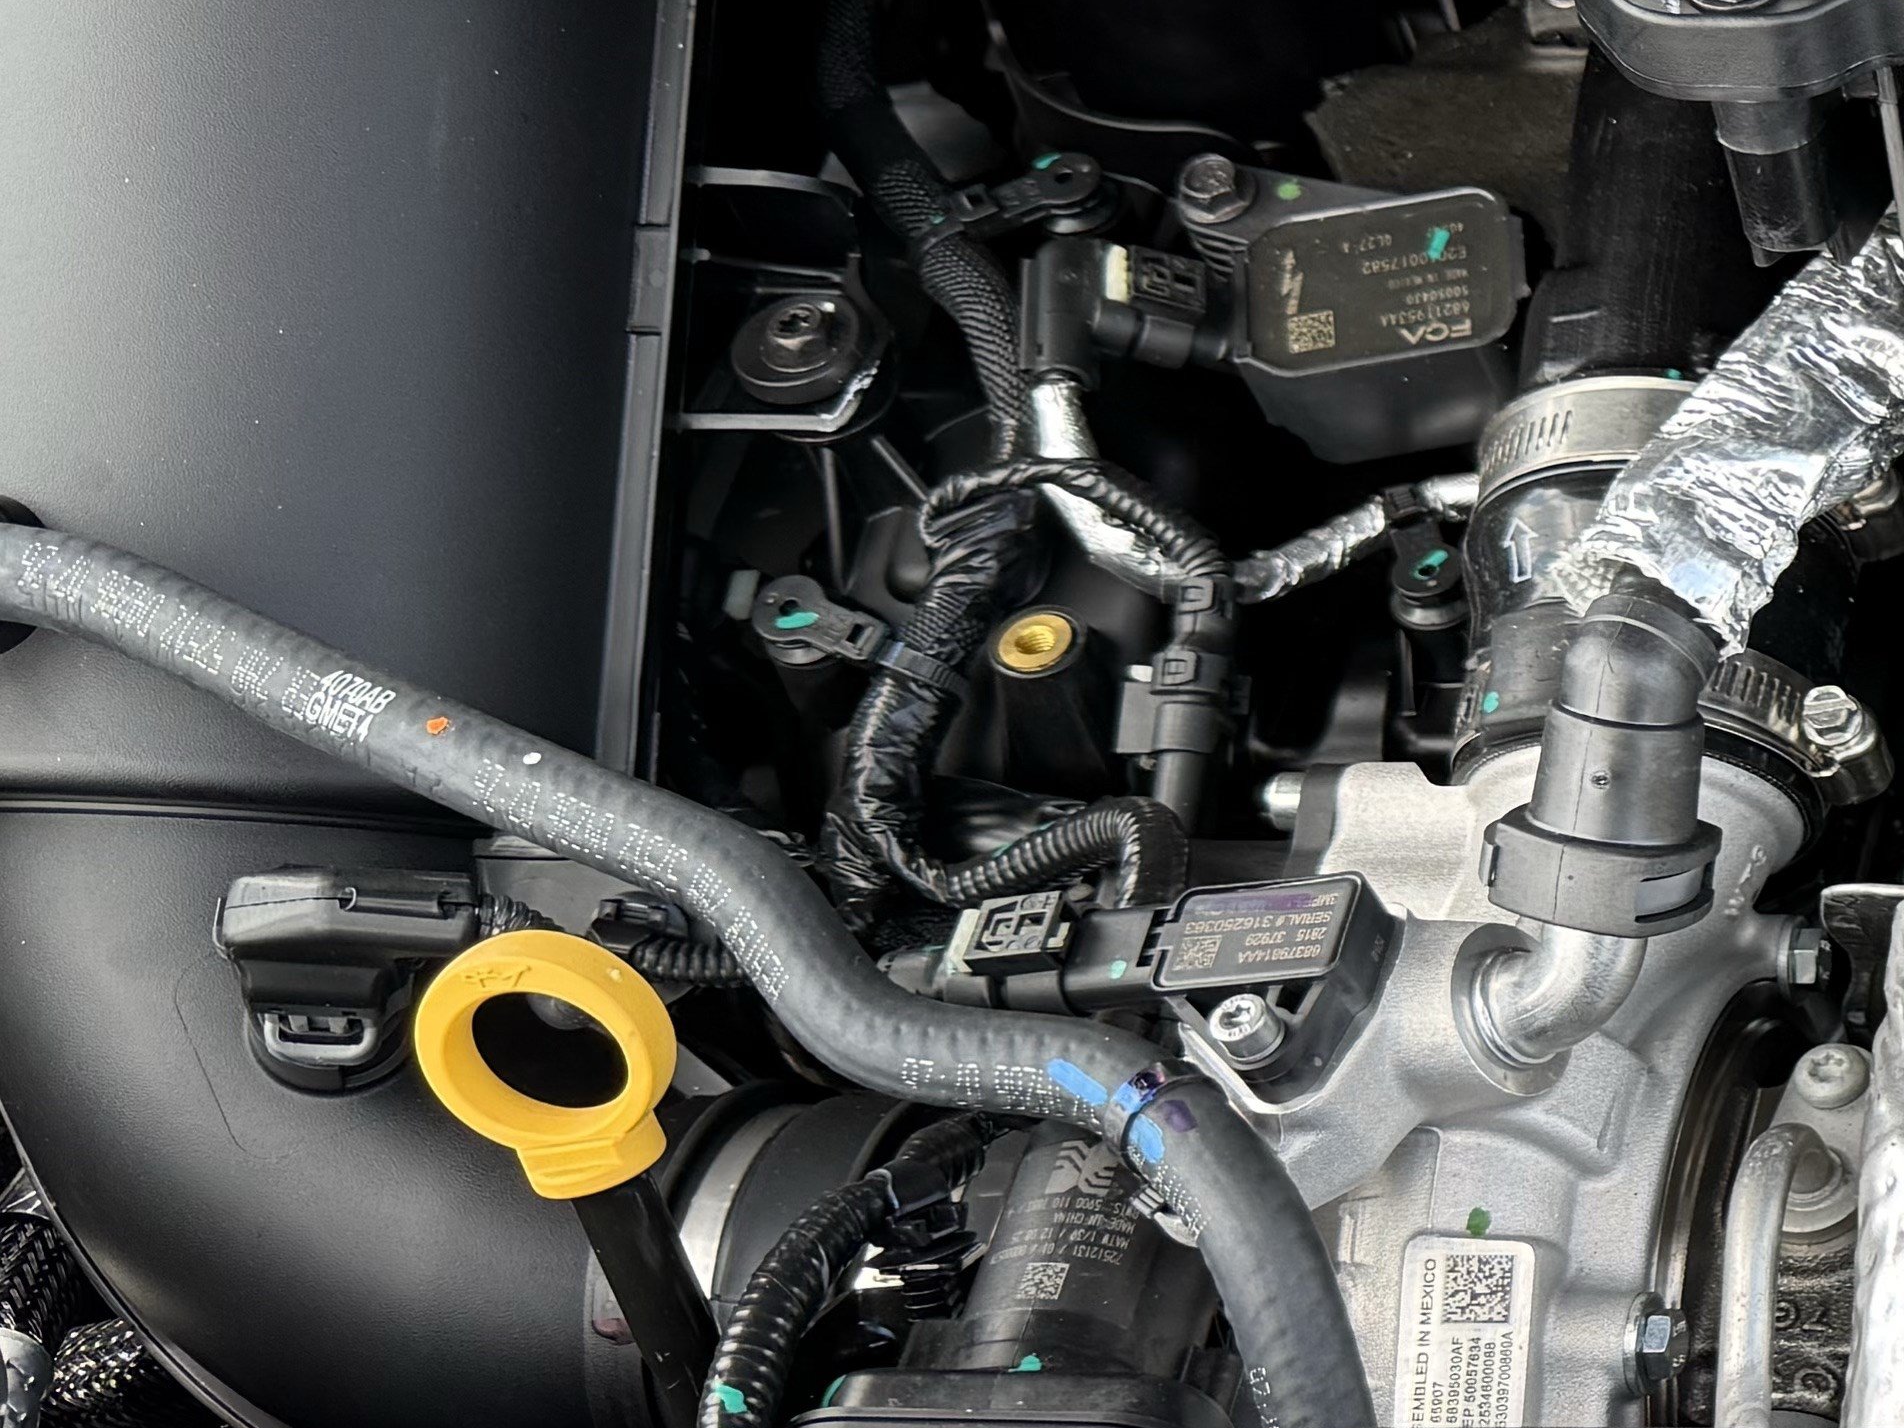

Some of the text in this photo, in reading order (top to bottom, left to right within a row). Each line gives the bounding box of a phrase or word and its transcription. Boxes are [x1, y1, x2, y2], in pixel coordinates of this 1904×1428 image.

[1395, 318, 1473, 346] FCA
[319, 669, 397, 715] 4070AB
[1289, 910, 1333, 926] SERIAL
[1419, 1258, 1437, 1325] MEXICO
[1417, 1330, 1432, 1348] IN
